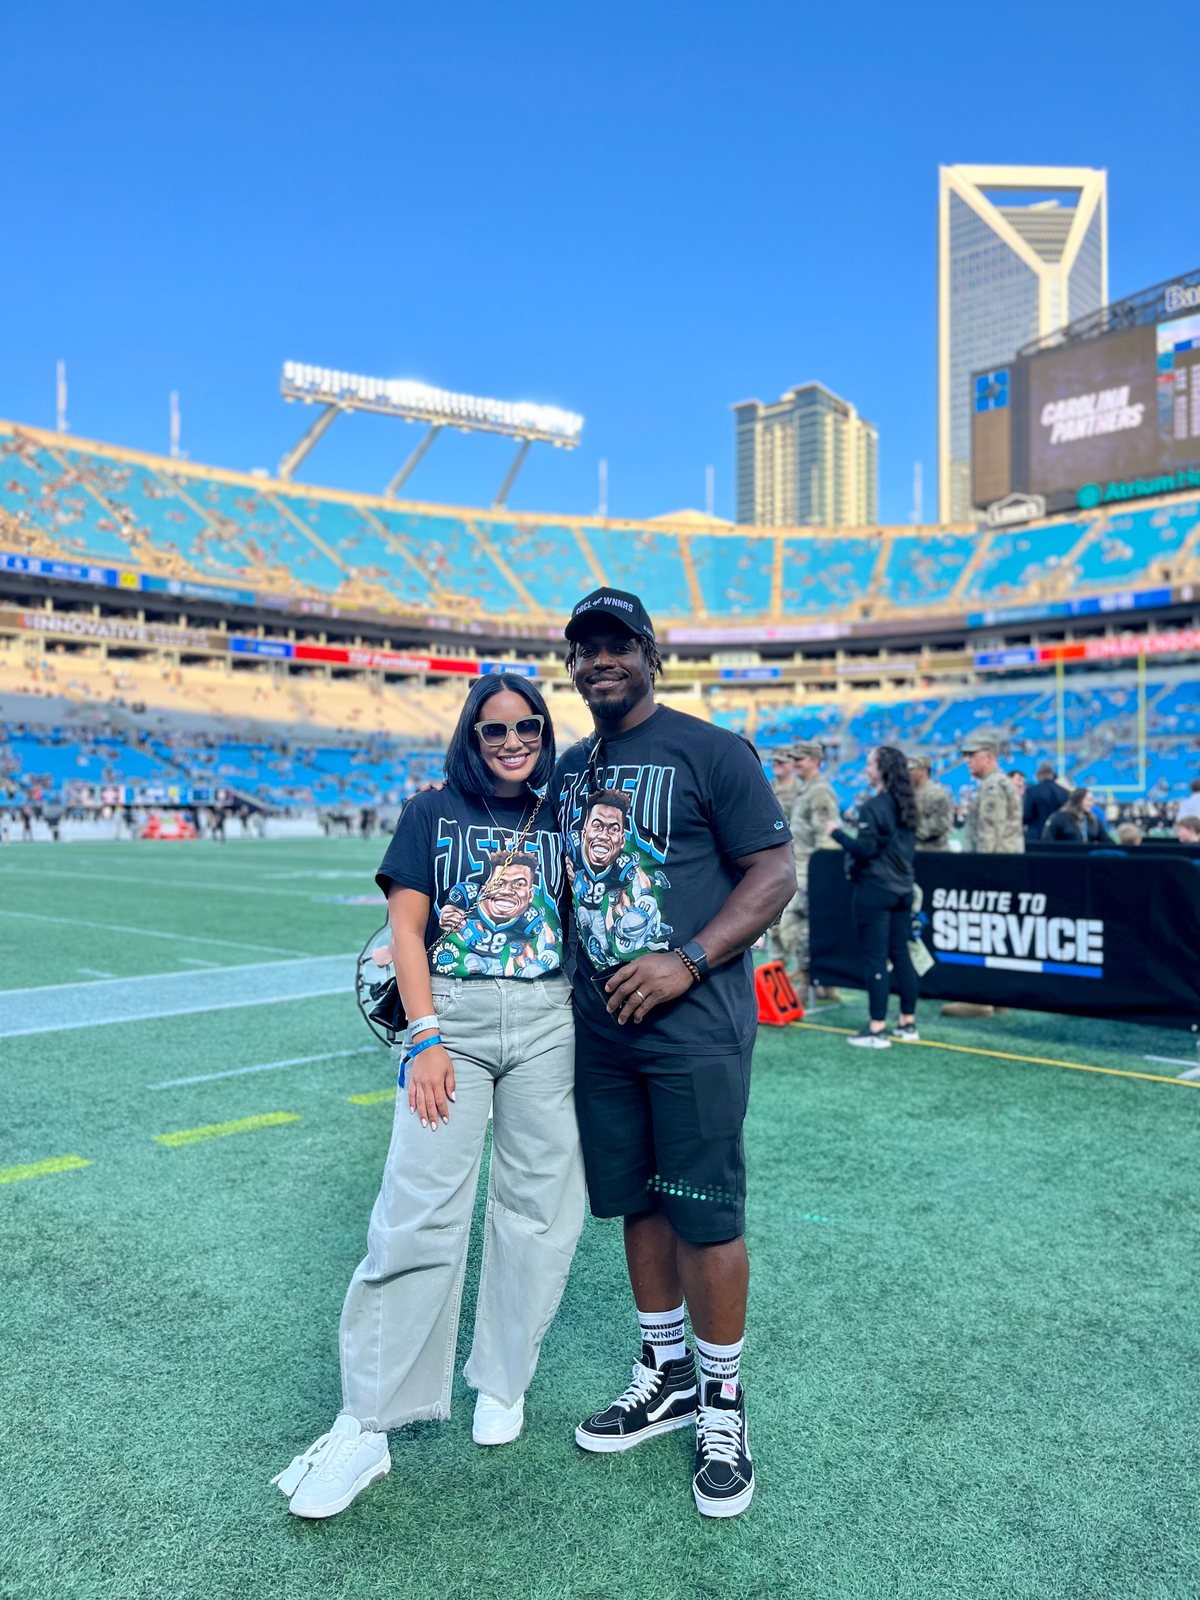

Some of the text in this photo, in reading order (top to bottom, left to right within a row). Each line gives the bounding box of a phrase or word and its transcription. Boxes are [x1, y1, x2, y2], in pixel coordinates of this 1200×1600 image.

[1041, 385, 1130, 426] CAROLINA
[1050, 403, 1145, 445] PANTHERS
[1104, 475, 1174, 503] Atrium
[603, 596, 633, 613] WNNRS
[33, 614, 148, 642] INNOVATIVE
[616, 852, 631, 869] 28
[465, 884, 478, 900] 28
[932, 888, 1047, 915] SALUTE TO
[524, 906, 539, 922] 28
[932, 910, 1104, 964] SERVICE
[763, 966, 799, 1014] 20
[651, 1327, 683, 1340] WNNRS
